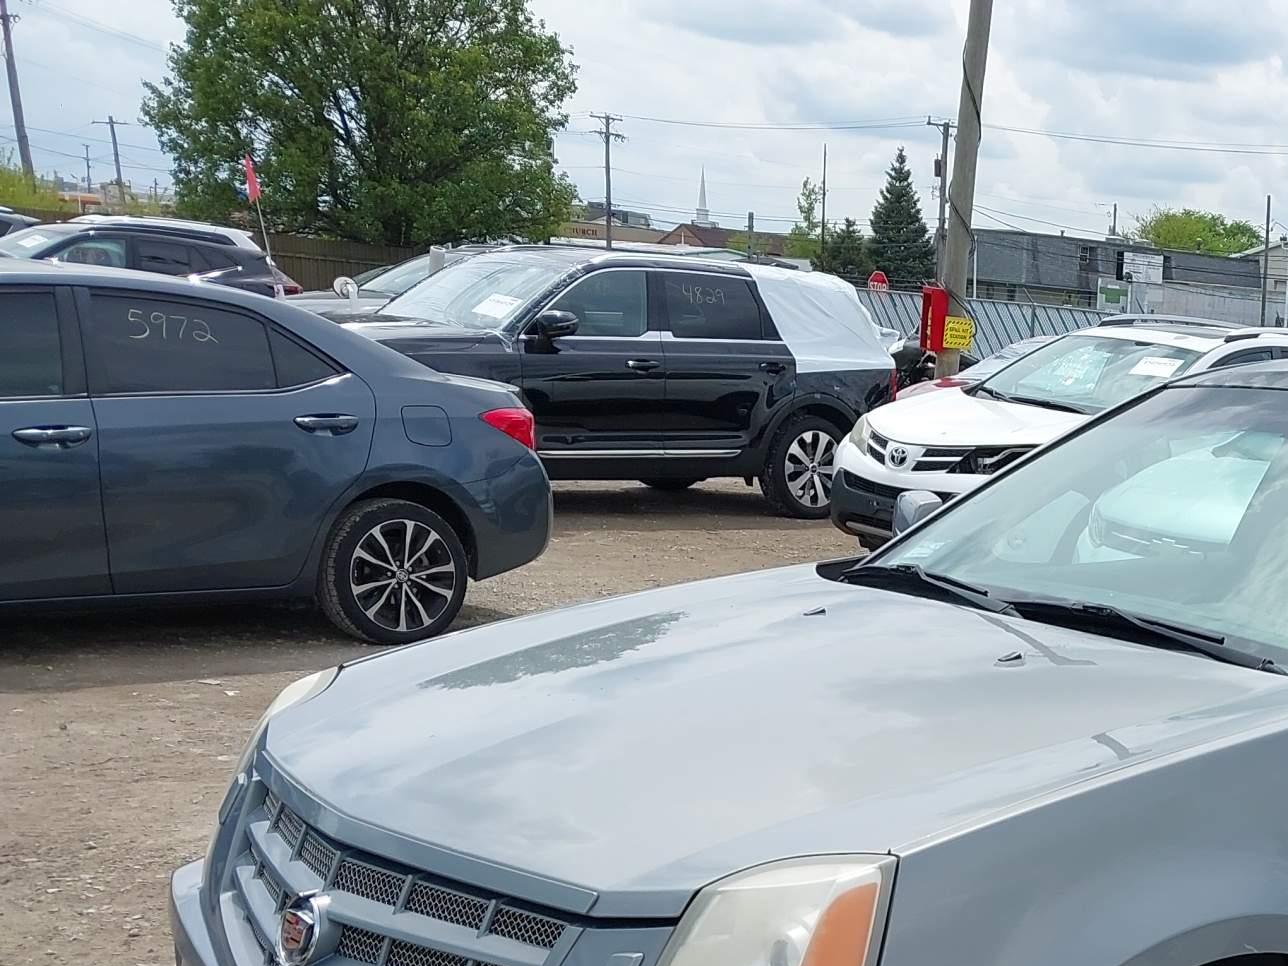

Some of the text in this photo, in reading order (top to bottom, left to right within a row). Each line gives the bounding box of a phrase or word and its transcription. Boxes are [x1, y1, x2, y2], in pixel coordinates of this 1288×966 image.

[682, 283, 725, 305] 4829
[870, 282, 887, 290] STOP
[128, 308, 219, 344] 5972
